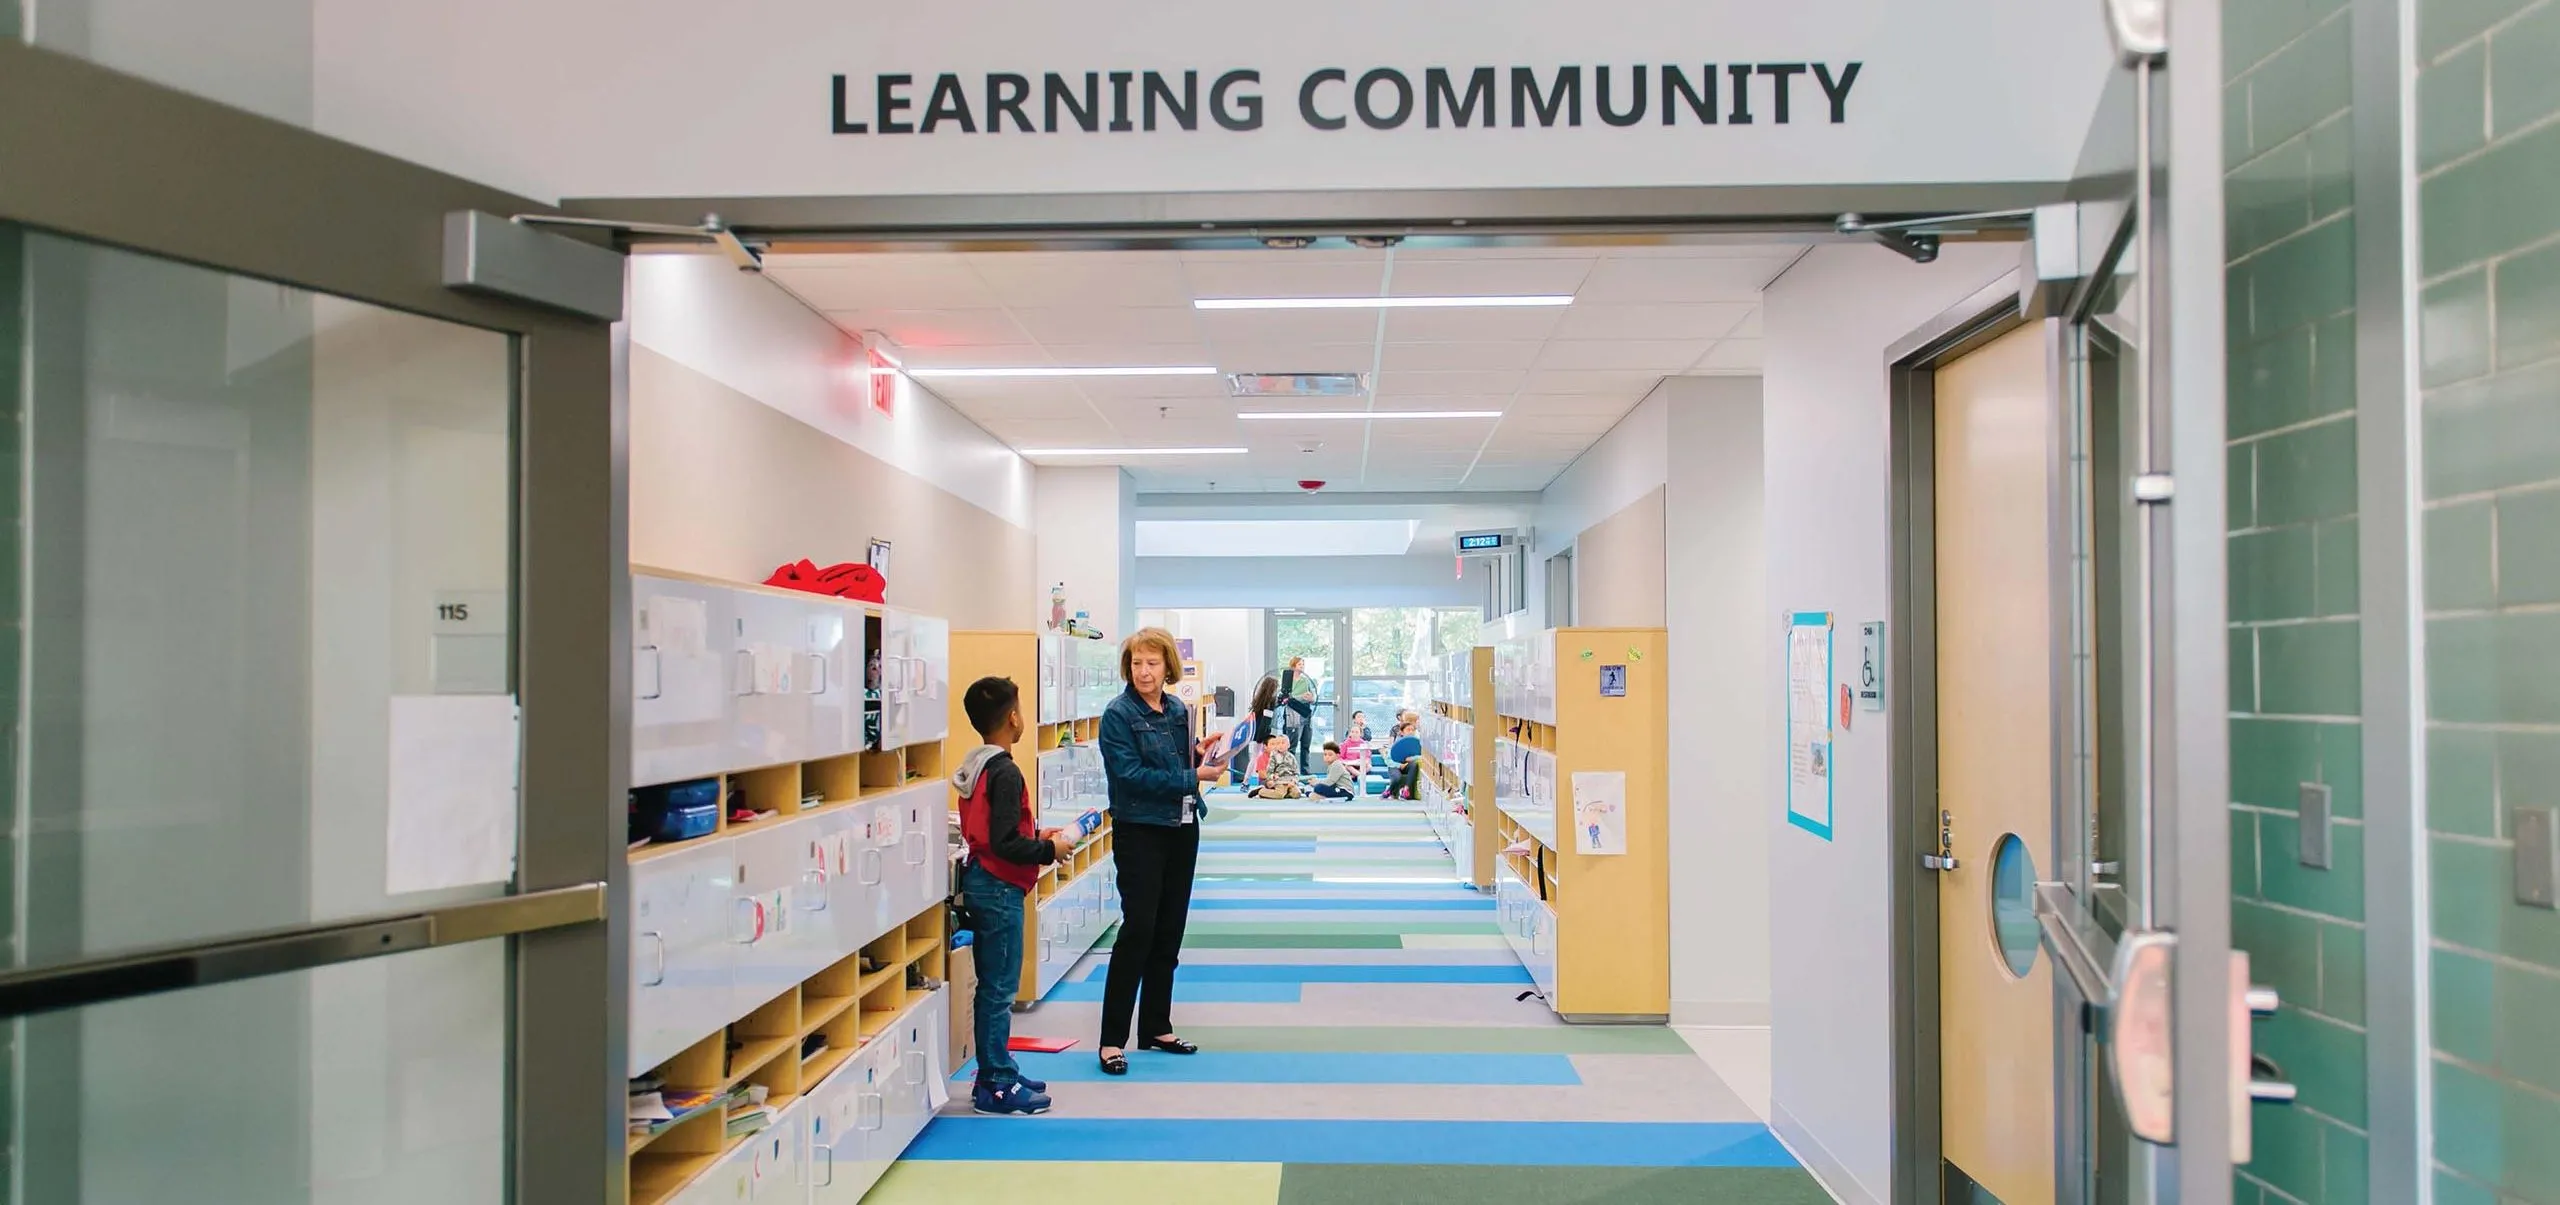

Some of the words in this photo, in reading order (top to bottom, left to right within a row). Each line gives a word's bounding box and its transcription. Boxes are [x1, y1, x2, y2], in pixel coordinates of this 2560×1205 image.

[832, 69, 1263, 135] LEARNING
[1298, 62, 1863, 130] COMMUNITY
[437, 603, 468, 621] 115
